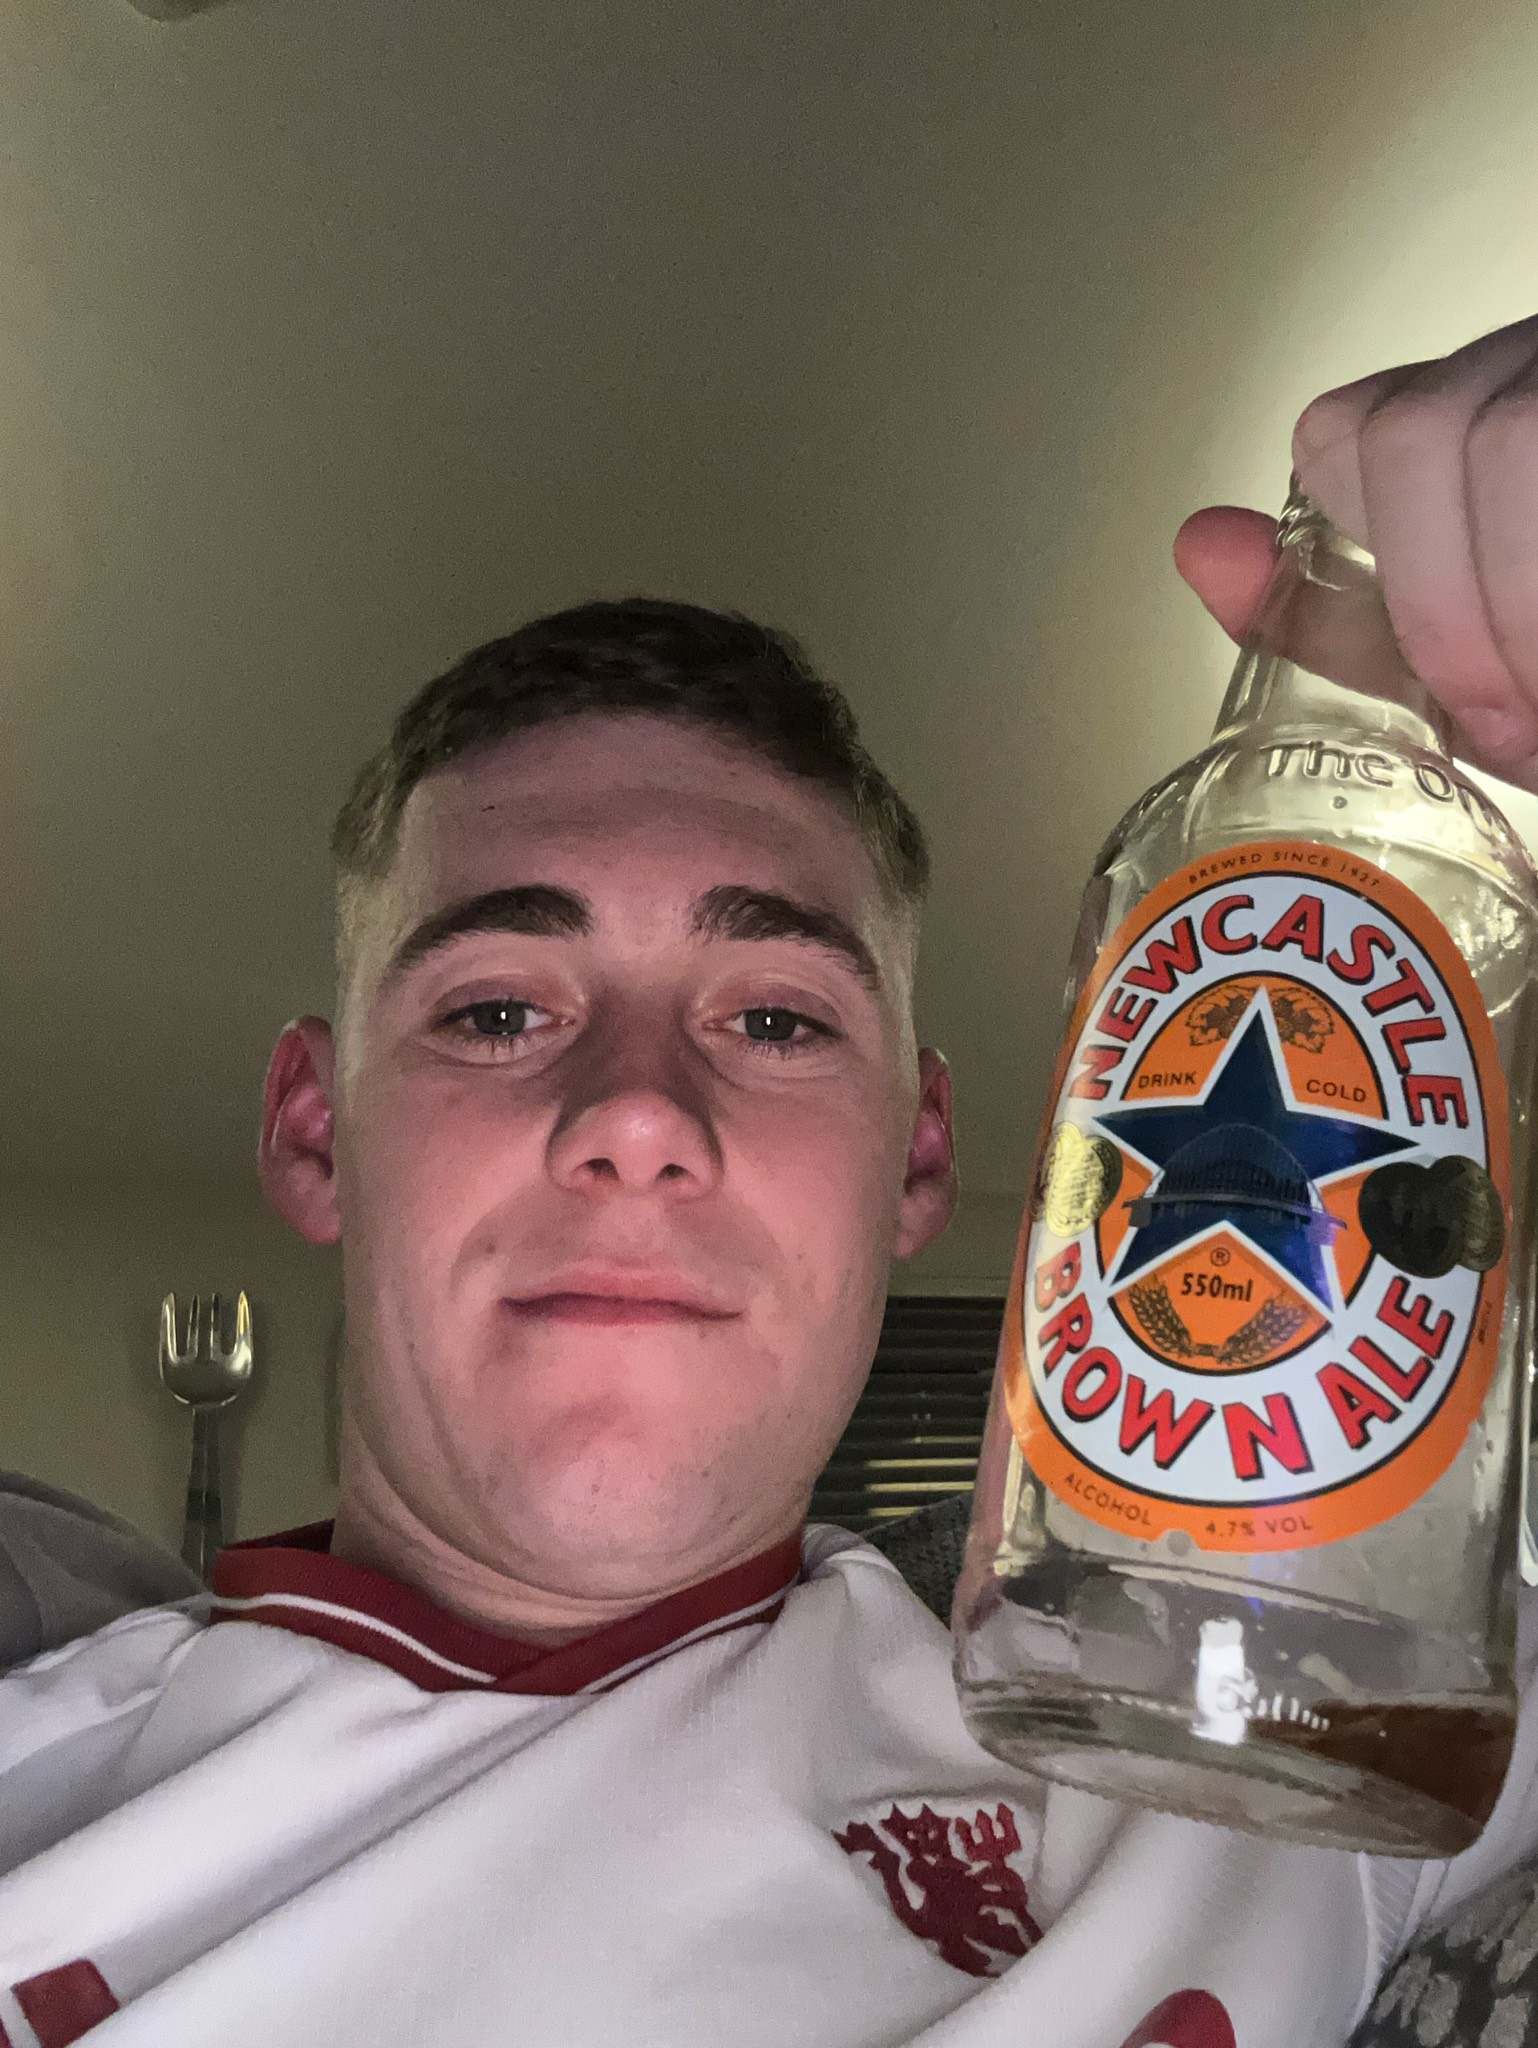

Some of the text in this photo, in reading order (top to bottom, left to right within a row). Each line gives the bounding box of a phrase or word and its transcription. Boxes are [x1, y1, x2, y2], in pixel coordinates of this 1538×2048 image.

[1259, 740, 1394, 788] The
[1189, 852, 1262, 884] BREWED
[1273, 852, 1329, 867] SINCE
[1069, 894, 1469, 1128] NEWCASTLE
[1138, 1071, 1367, 1102] DRINK COLD
[1181, 1272, 1253, 1302] 550ml
[1035, 1243, 1454, 1481] BROWN ALE
[1065, 1473, 1314, 1536] ALCOHOL 4.7% VOL
